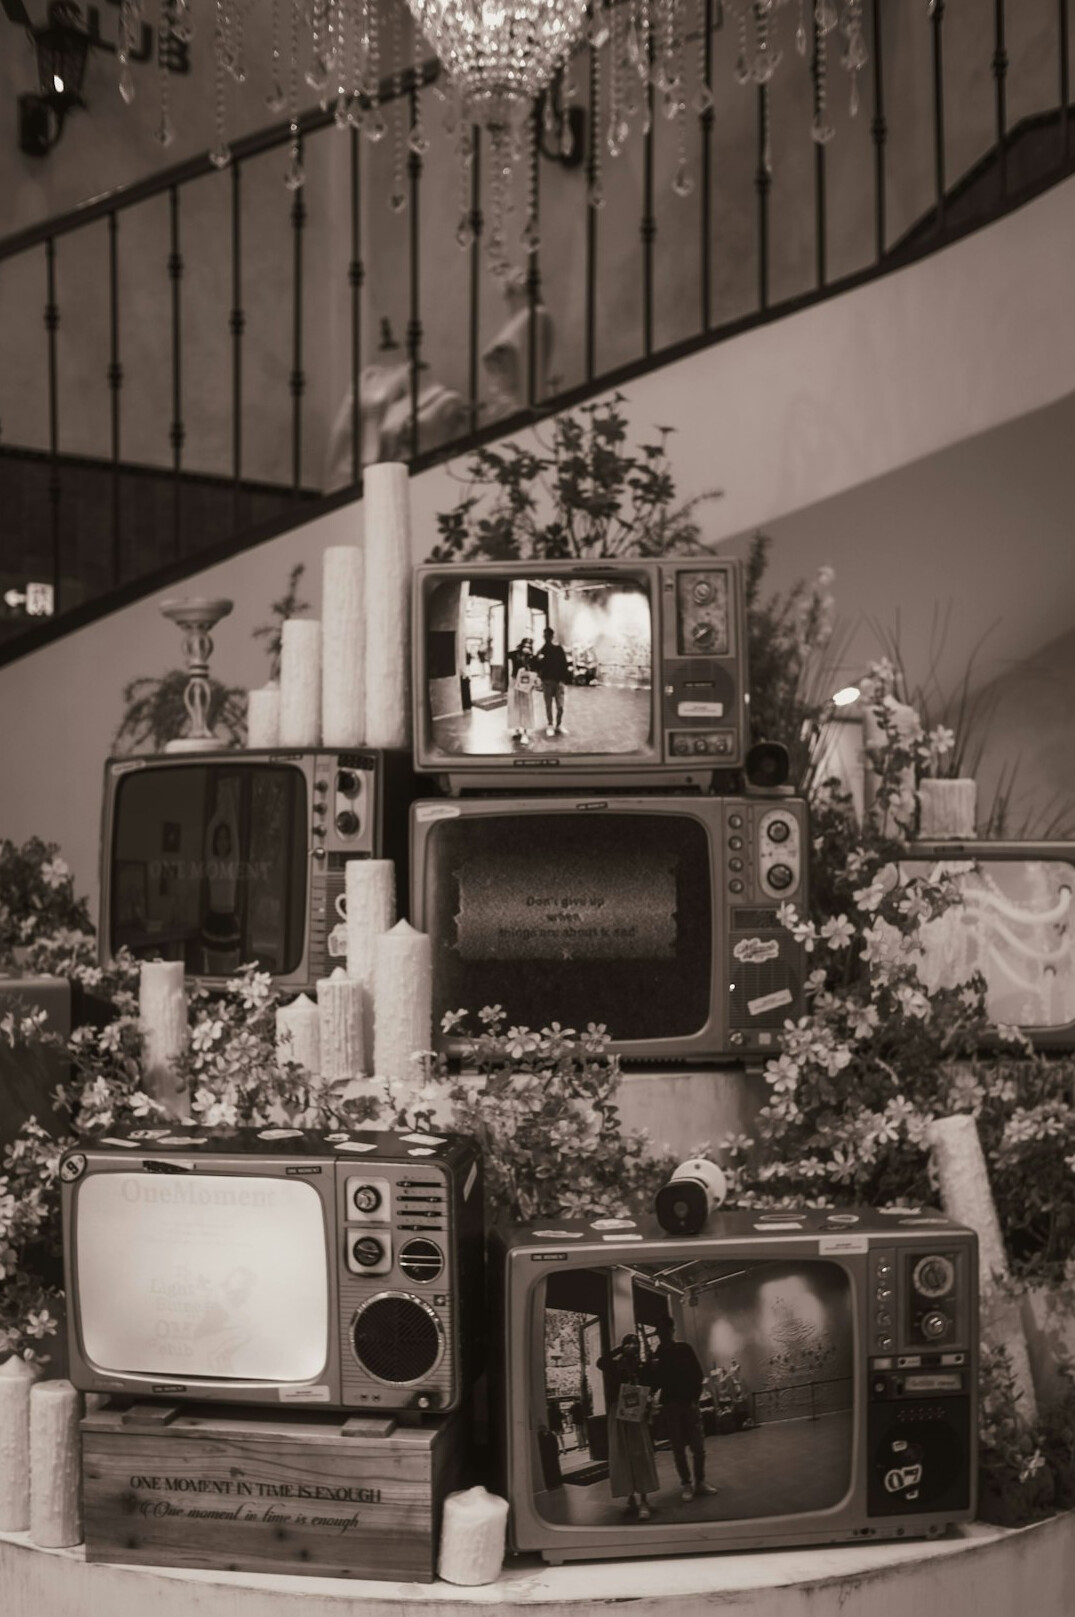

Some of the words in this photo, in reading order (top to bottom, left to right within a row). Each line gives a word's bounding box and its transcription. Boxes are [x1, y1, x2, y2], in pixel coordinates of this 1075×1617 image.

[190, 860, 272, 881] MOMENT
[121, 1178, 276, 1207] OneMoment
[130, 1475, 161, 1491] ONE
[164, 1477, 233, 1495] MOMENT
[236, 1481, 252, 1496] IN
[255, 1482, 294, 1499] TIME
[297, 1484, 312, 1500] IS
[314, 1486, 382, 1504] ENOUGH
[186, 1501, 257, 1520] moment
[244, 1509, 258, 1521] in
[261, 1502, 292, 1524] time
[294, 1512, 308, 1526] is
[310, 1511, 361, 1536] enough
